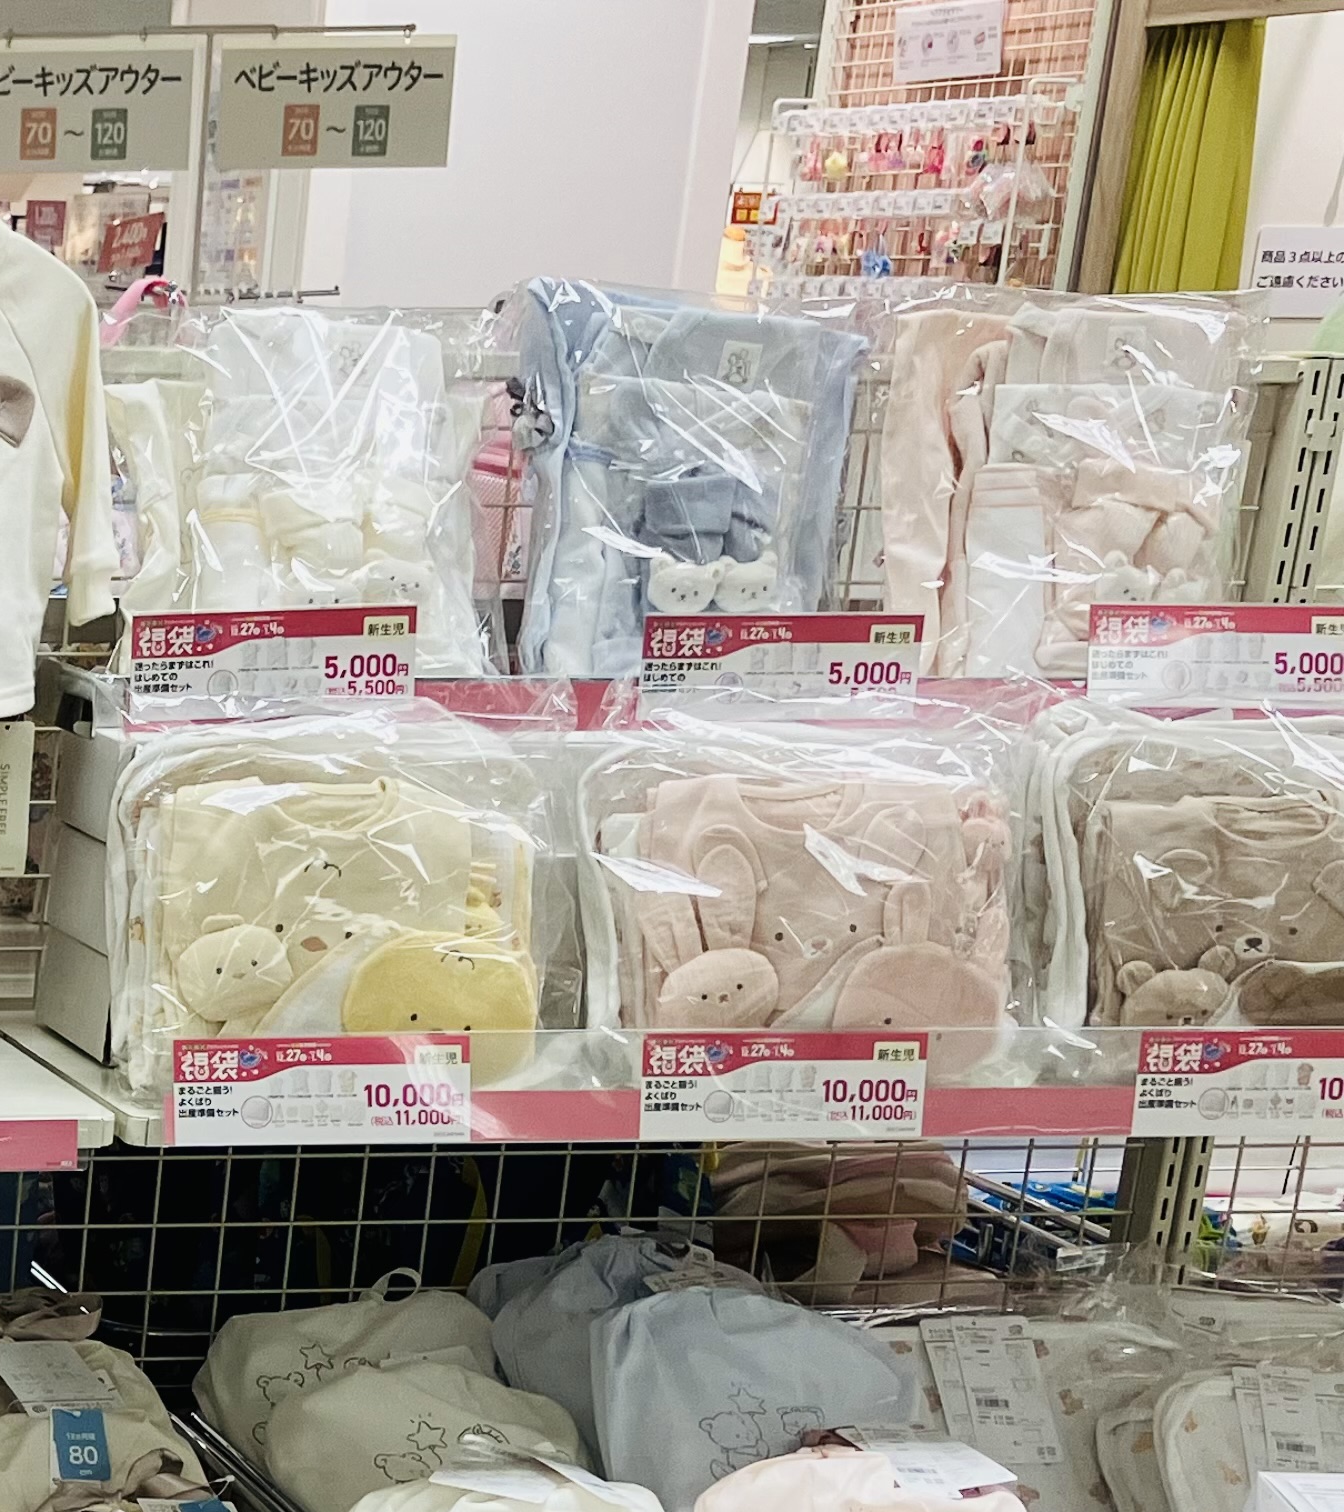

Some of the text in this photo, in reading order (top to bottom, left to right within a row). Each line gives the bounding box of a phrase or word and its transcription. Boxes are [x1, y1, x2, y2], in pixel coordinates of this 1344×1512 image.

[234, 60, 443, 93] ベビーキッズアウター
[25, 122, 125, 144] 70 120
[288, 118, 386, 141] 70 120
[368, 624, 405, 636] 新生児
[874, 631, 910, 644] 新生児
[324, 654, 408, 678] 5,000円
[829, 662, 912, 684] 5,000円
[878, 1048, 915, 1062] 新生児
[822, 1079, 917, 1103] 10,000円
[69, 1445, 98, 1465] 80
